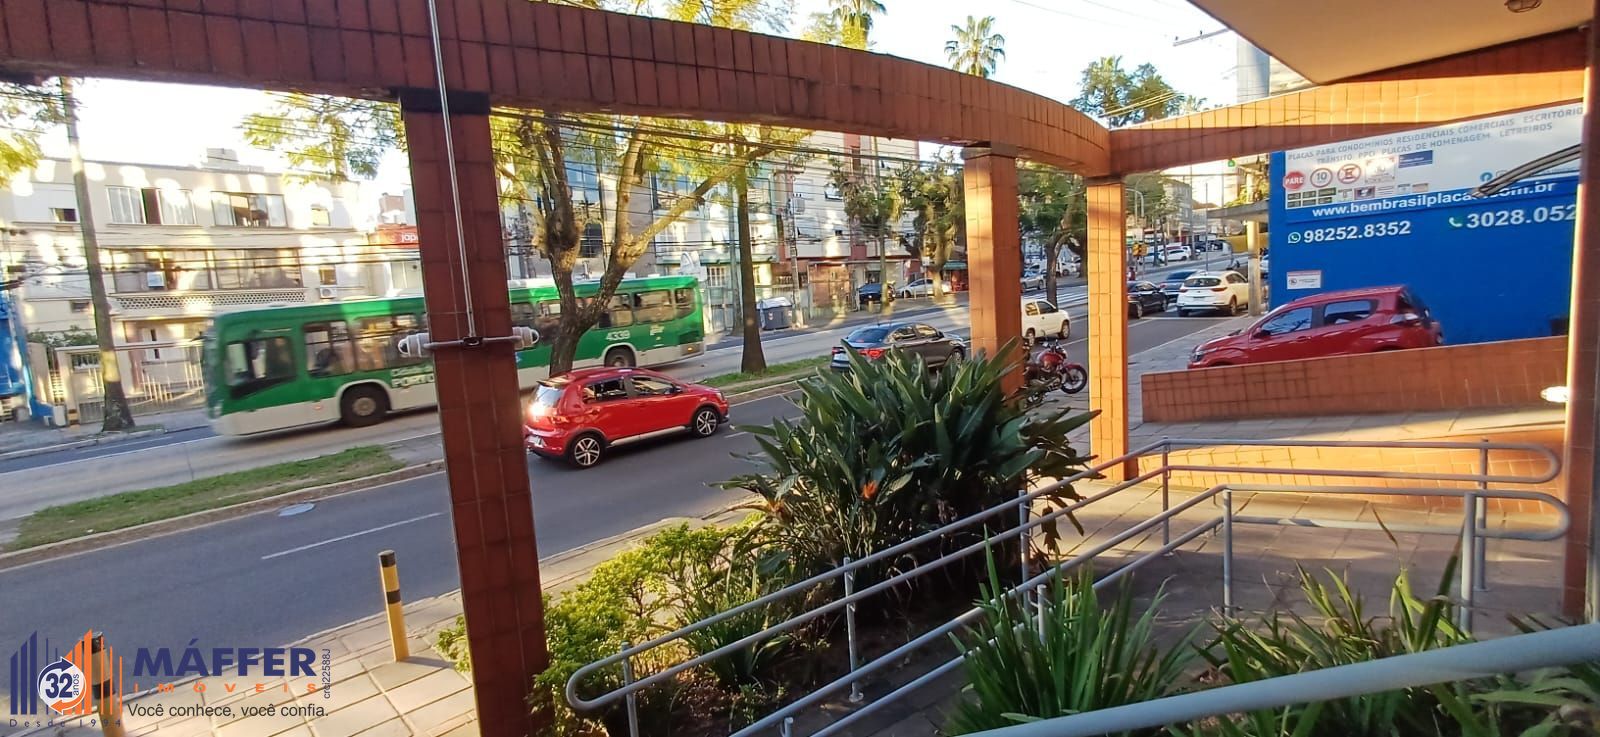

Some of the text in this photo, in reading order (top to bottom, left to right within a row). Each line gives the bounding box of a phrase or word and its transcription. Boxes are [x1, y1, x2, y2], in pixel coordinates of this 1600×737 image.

[1288, 151, 1314, 161] PLACAS
[1316, 147, 1336, 157] PARA
[1396, 129, 1454, 143] RESIDENCIAIS
[1457, 118, 1515, 134] COMERCIAIS
[1381, 145, 1412, 156] PLACAS
[1415, 141, 1427, 150] DE
[1499, 121, 1553, 138] LETREIROS
[1285, 176, 1304, 185] PARE
[1316, 171, 1328, 181] 10
[1303, 220, 1411, 244] 98252.8352
